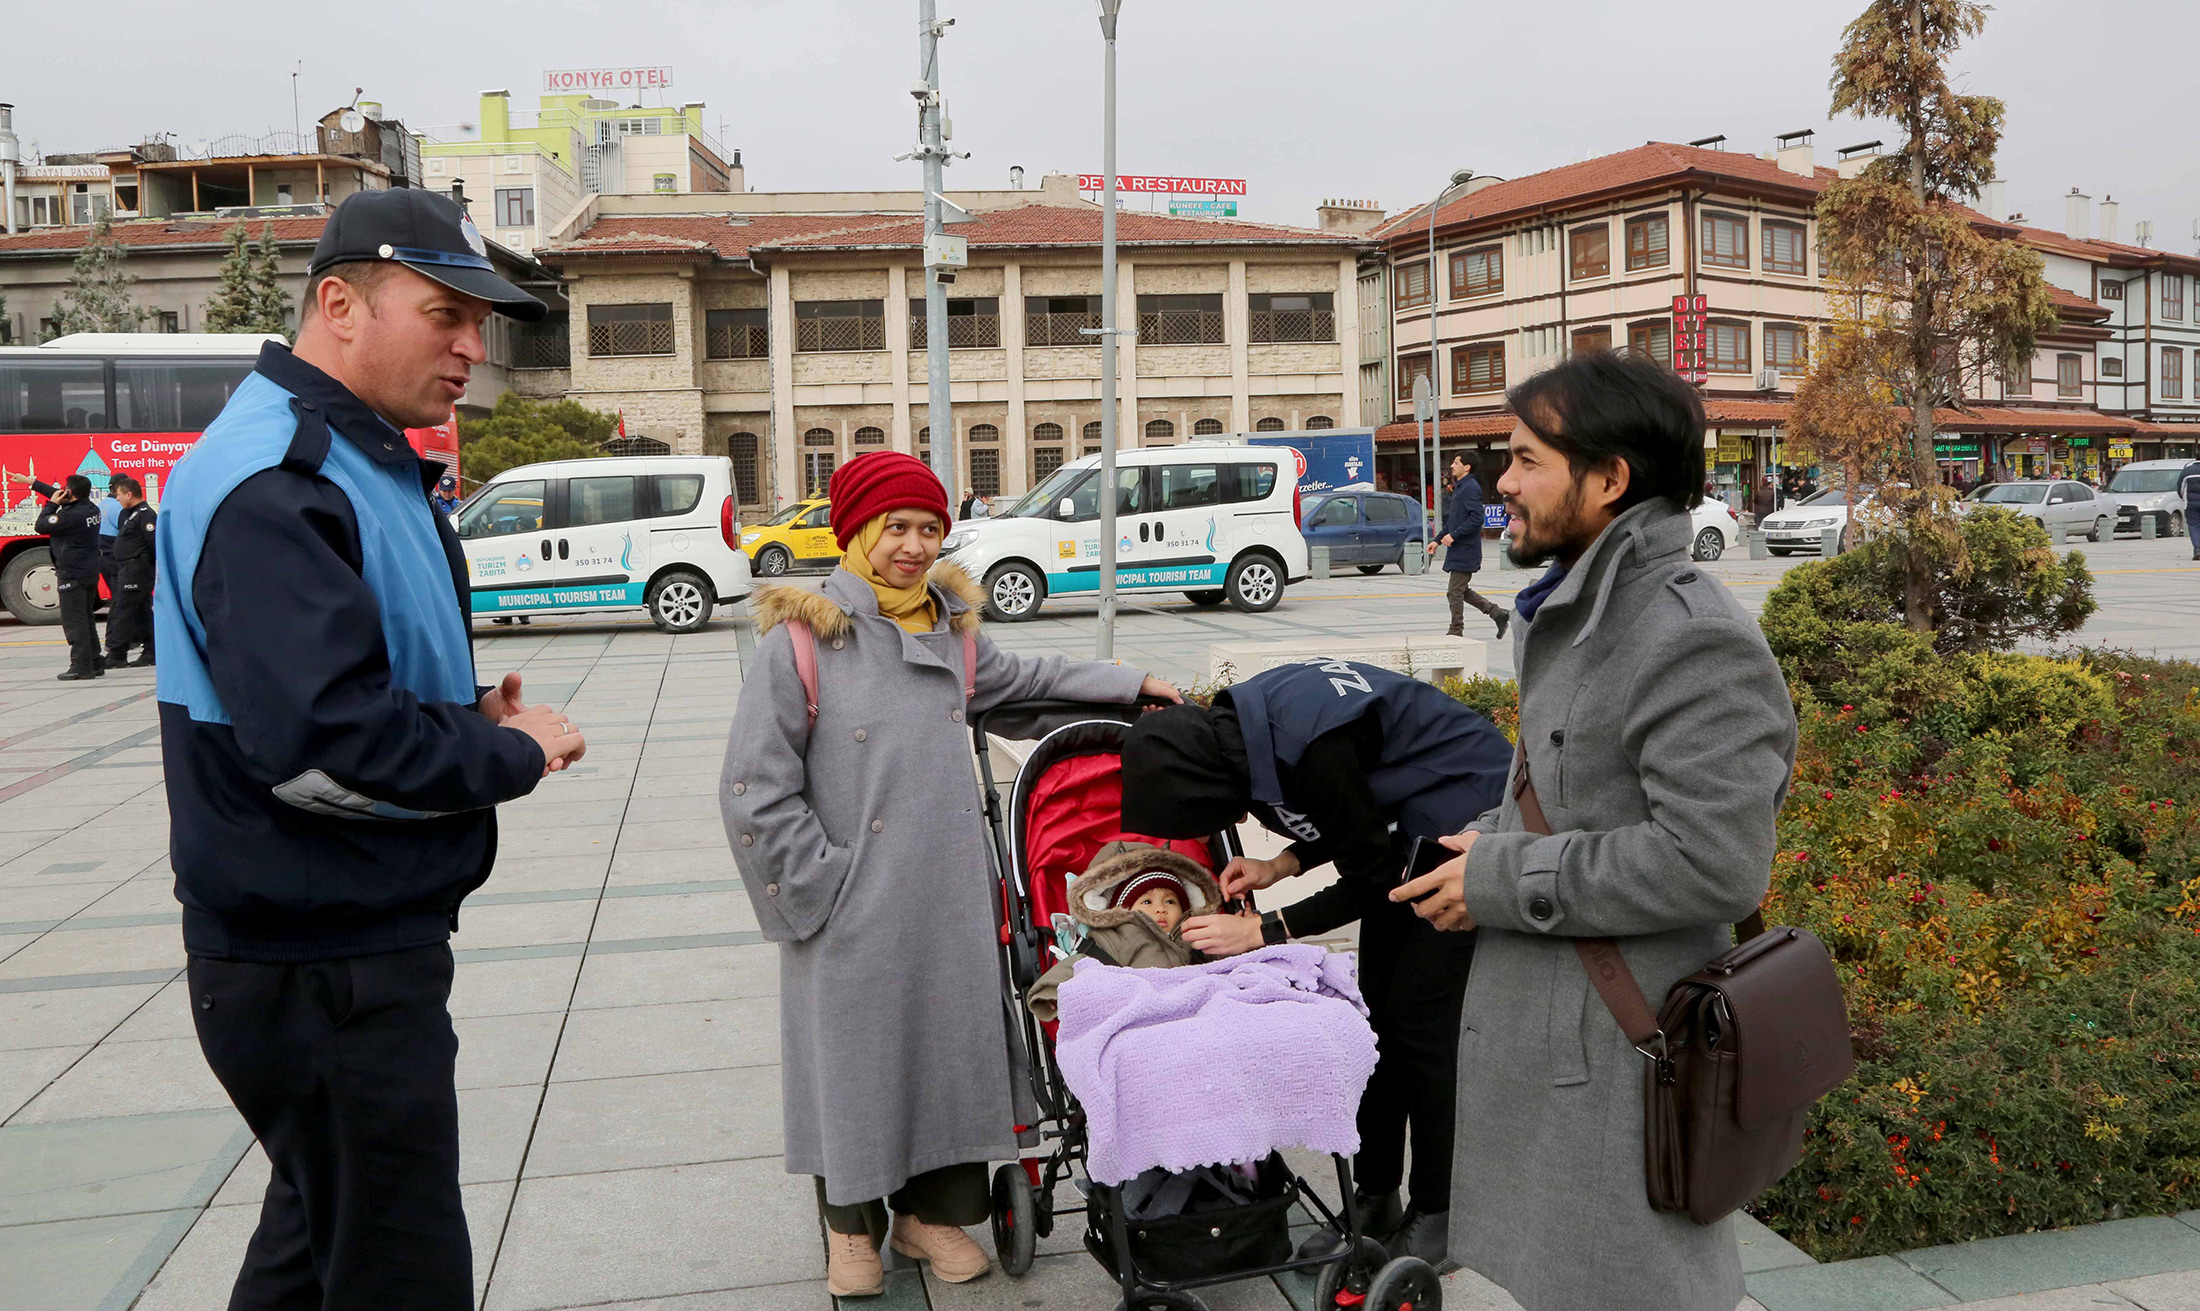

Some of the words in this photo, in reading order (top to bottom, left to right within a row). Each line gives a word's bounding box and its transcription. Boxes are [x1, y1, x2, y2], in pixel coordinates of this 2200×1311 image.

[548, 71, 613, 88] KONYA
[619, 69, 669, 86] OTEL
[14, 168, 28, 177] TEL
[71, 167, 110, 177] PANSİYO
[1079, 175, 1126, 190] DEA
[1132, 177, 1246, 194] RESTAURAN
[1176, 209, 1226, 217] RESTAURANT
[1673, 296, 1690, 369] OTEL
[1693, 296, 1707, 368] OTEL
[111, 439, 137, 452] Gez
[2114, 449, 2125, 457] 10
[111, 458, 145, 468] Travel
[147, 457, 165, 468] the
[1485, 505, 1505, 517] OTE
[1084, 543, 1101, 551] TURİ
[1166, 540, 1180, 548] 350
[575, 559, 590, 567] 350
[591, 558, 601, 566] 31
[479, 569, 506, 577] ZABITA
[1115, 572, 1147, 586] NICIPAL
[1148, 570, 1187, 583] TOURISM
[1188, 568, 1212, 581] TEAM
[498, 593, 552, 607] MUNICIPAL
[553, 590, 598, 604] TOURISM
[599, 588, 626, 601] TEAM
